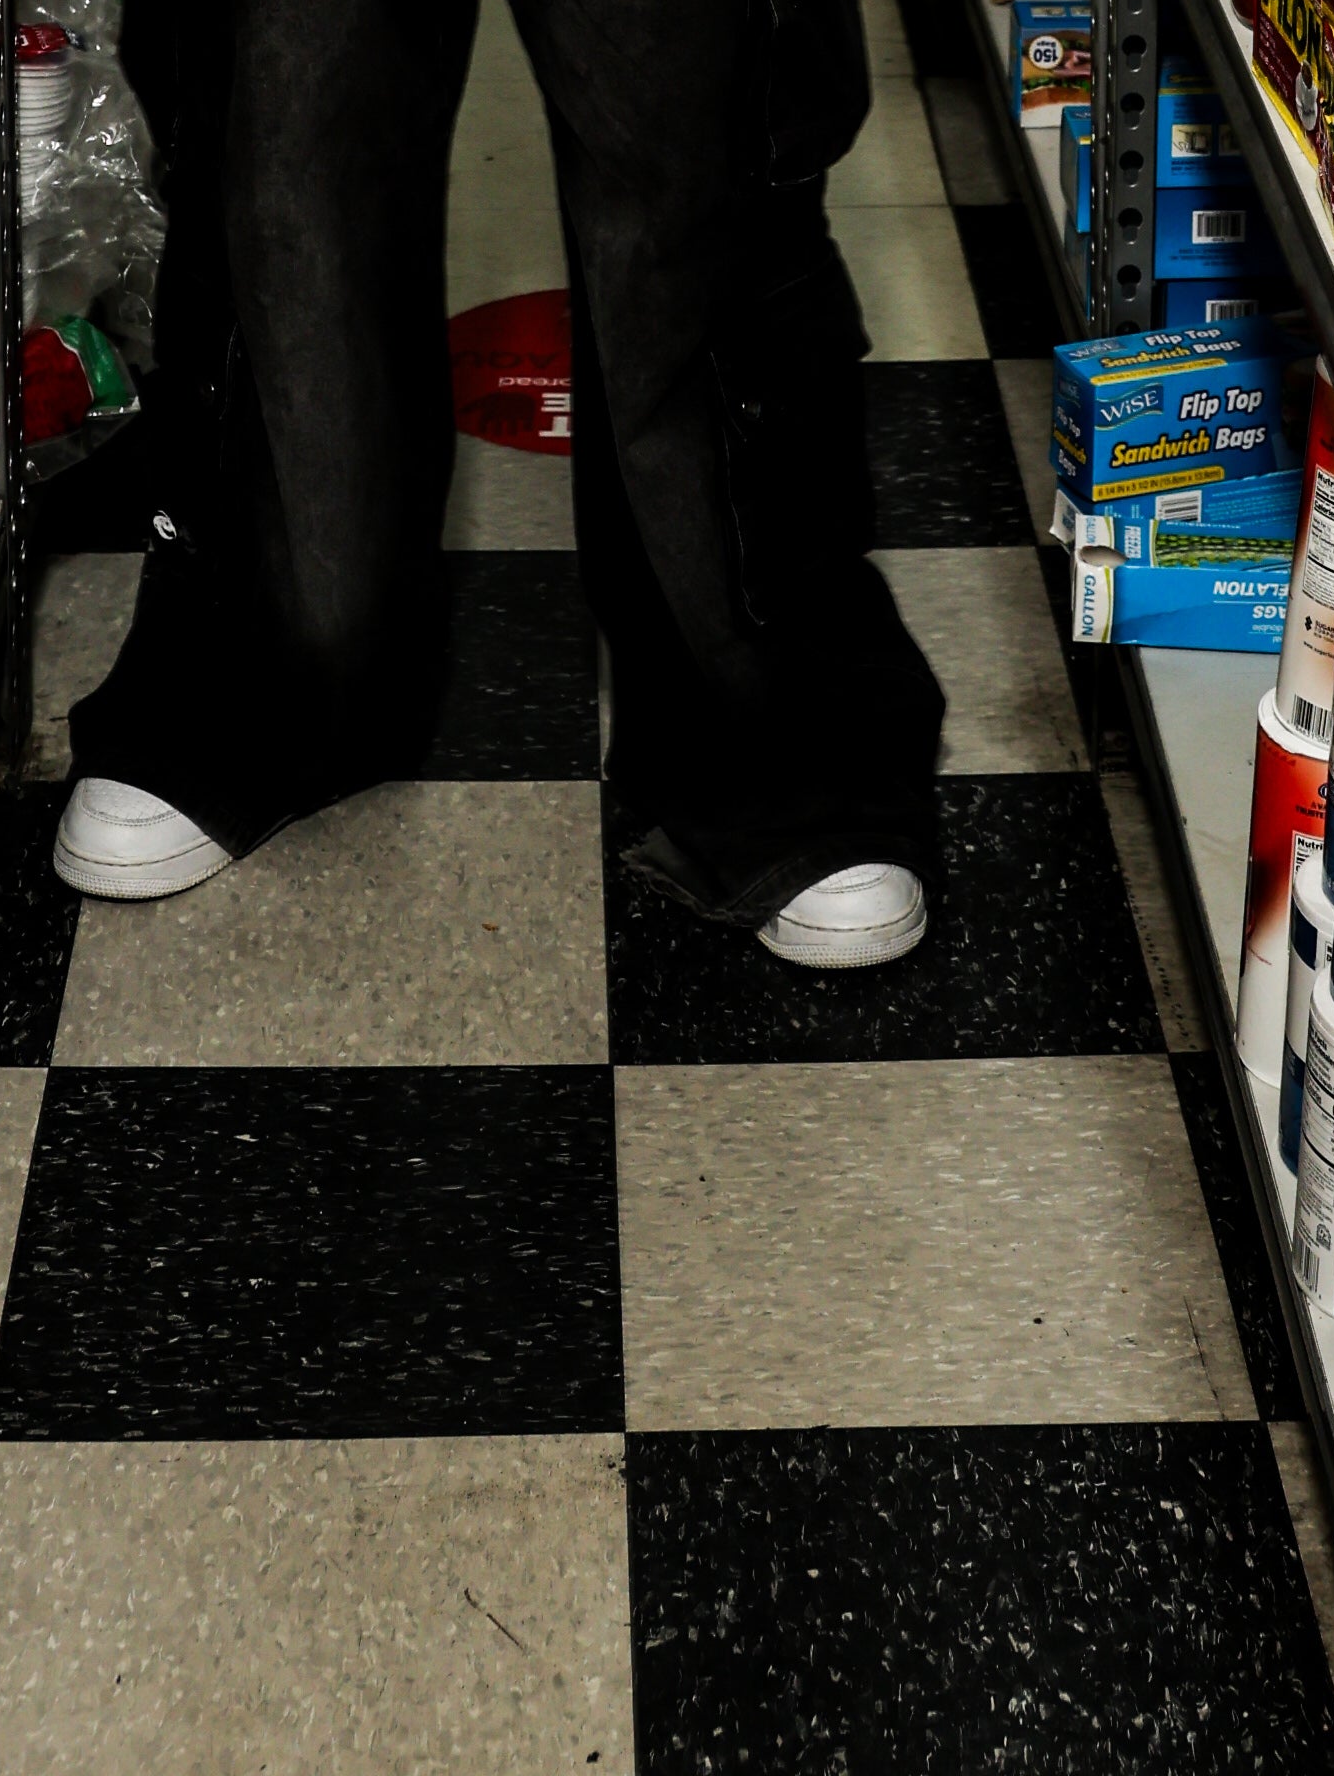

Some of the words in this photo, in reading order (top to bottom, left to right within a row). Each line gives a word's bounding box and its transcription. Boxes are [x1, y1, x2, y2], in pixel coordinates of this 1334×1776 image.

[1180, 392, 1219, 420] Flip
[1226, 389, 1263, 412] Top
[1112, 431, 1210, 467] Sandwich
[1216, 426, 1266, 450] Bags
[1082, 575, 1096, 637] GALLON
